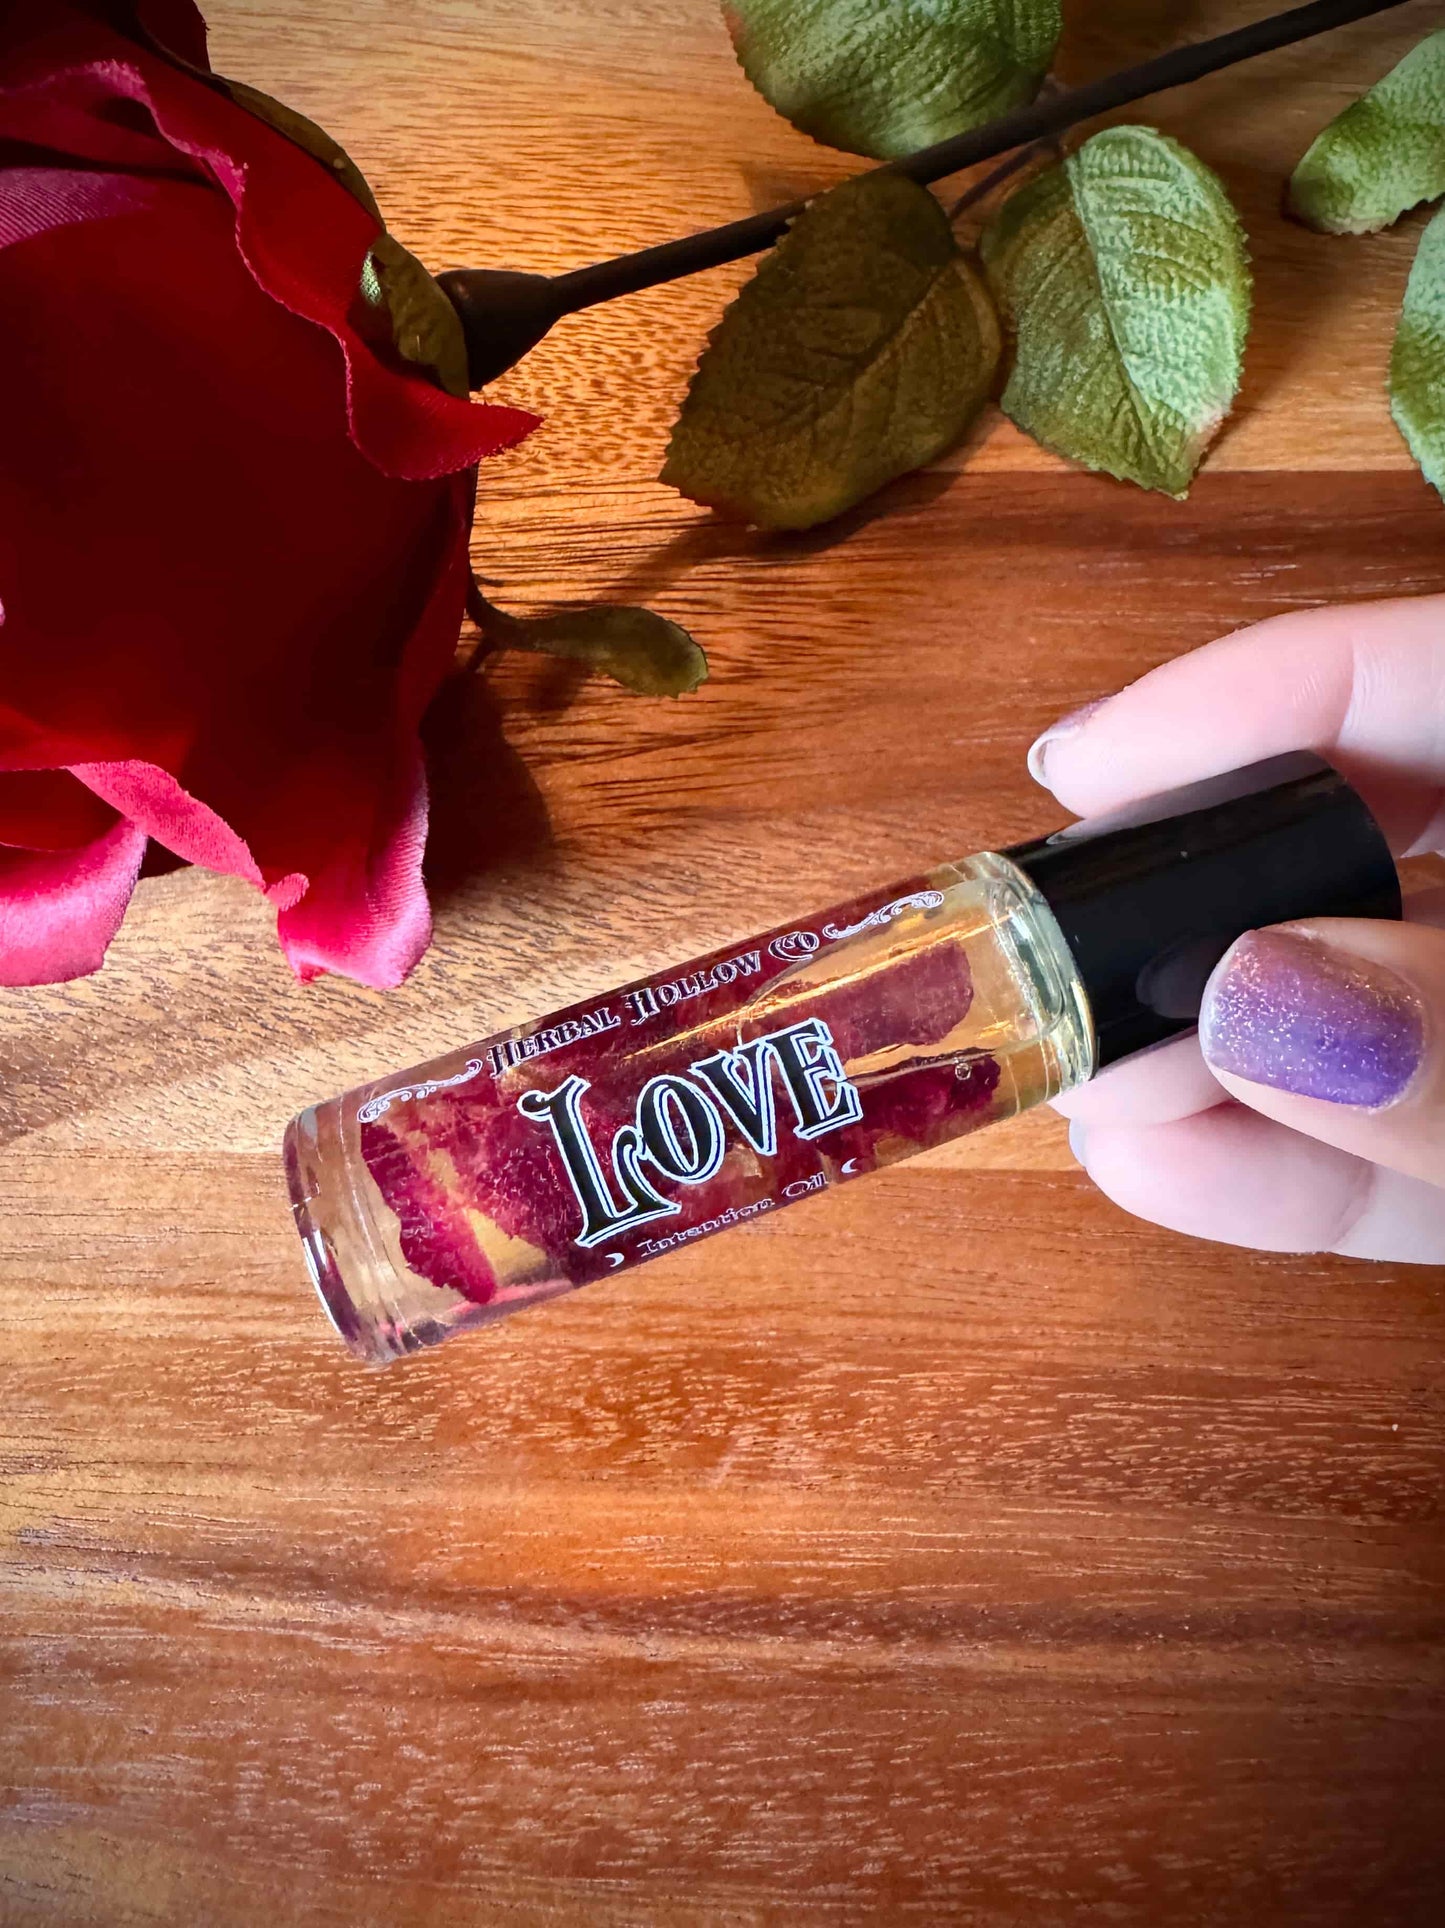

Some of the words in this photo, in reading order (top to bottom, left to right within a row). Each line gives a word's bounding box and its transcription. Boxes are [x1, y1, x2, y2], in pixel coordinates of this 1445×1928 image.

[487, 1007, 621, 1079] HERBAL
[622, 950, 761, 1025] HOLLOW
[518, 1018, 864, 1249] LOVE
[636, 1198, 776, 1257] Intention
[781, 1171, 828, 1198] Oil
